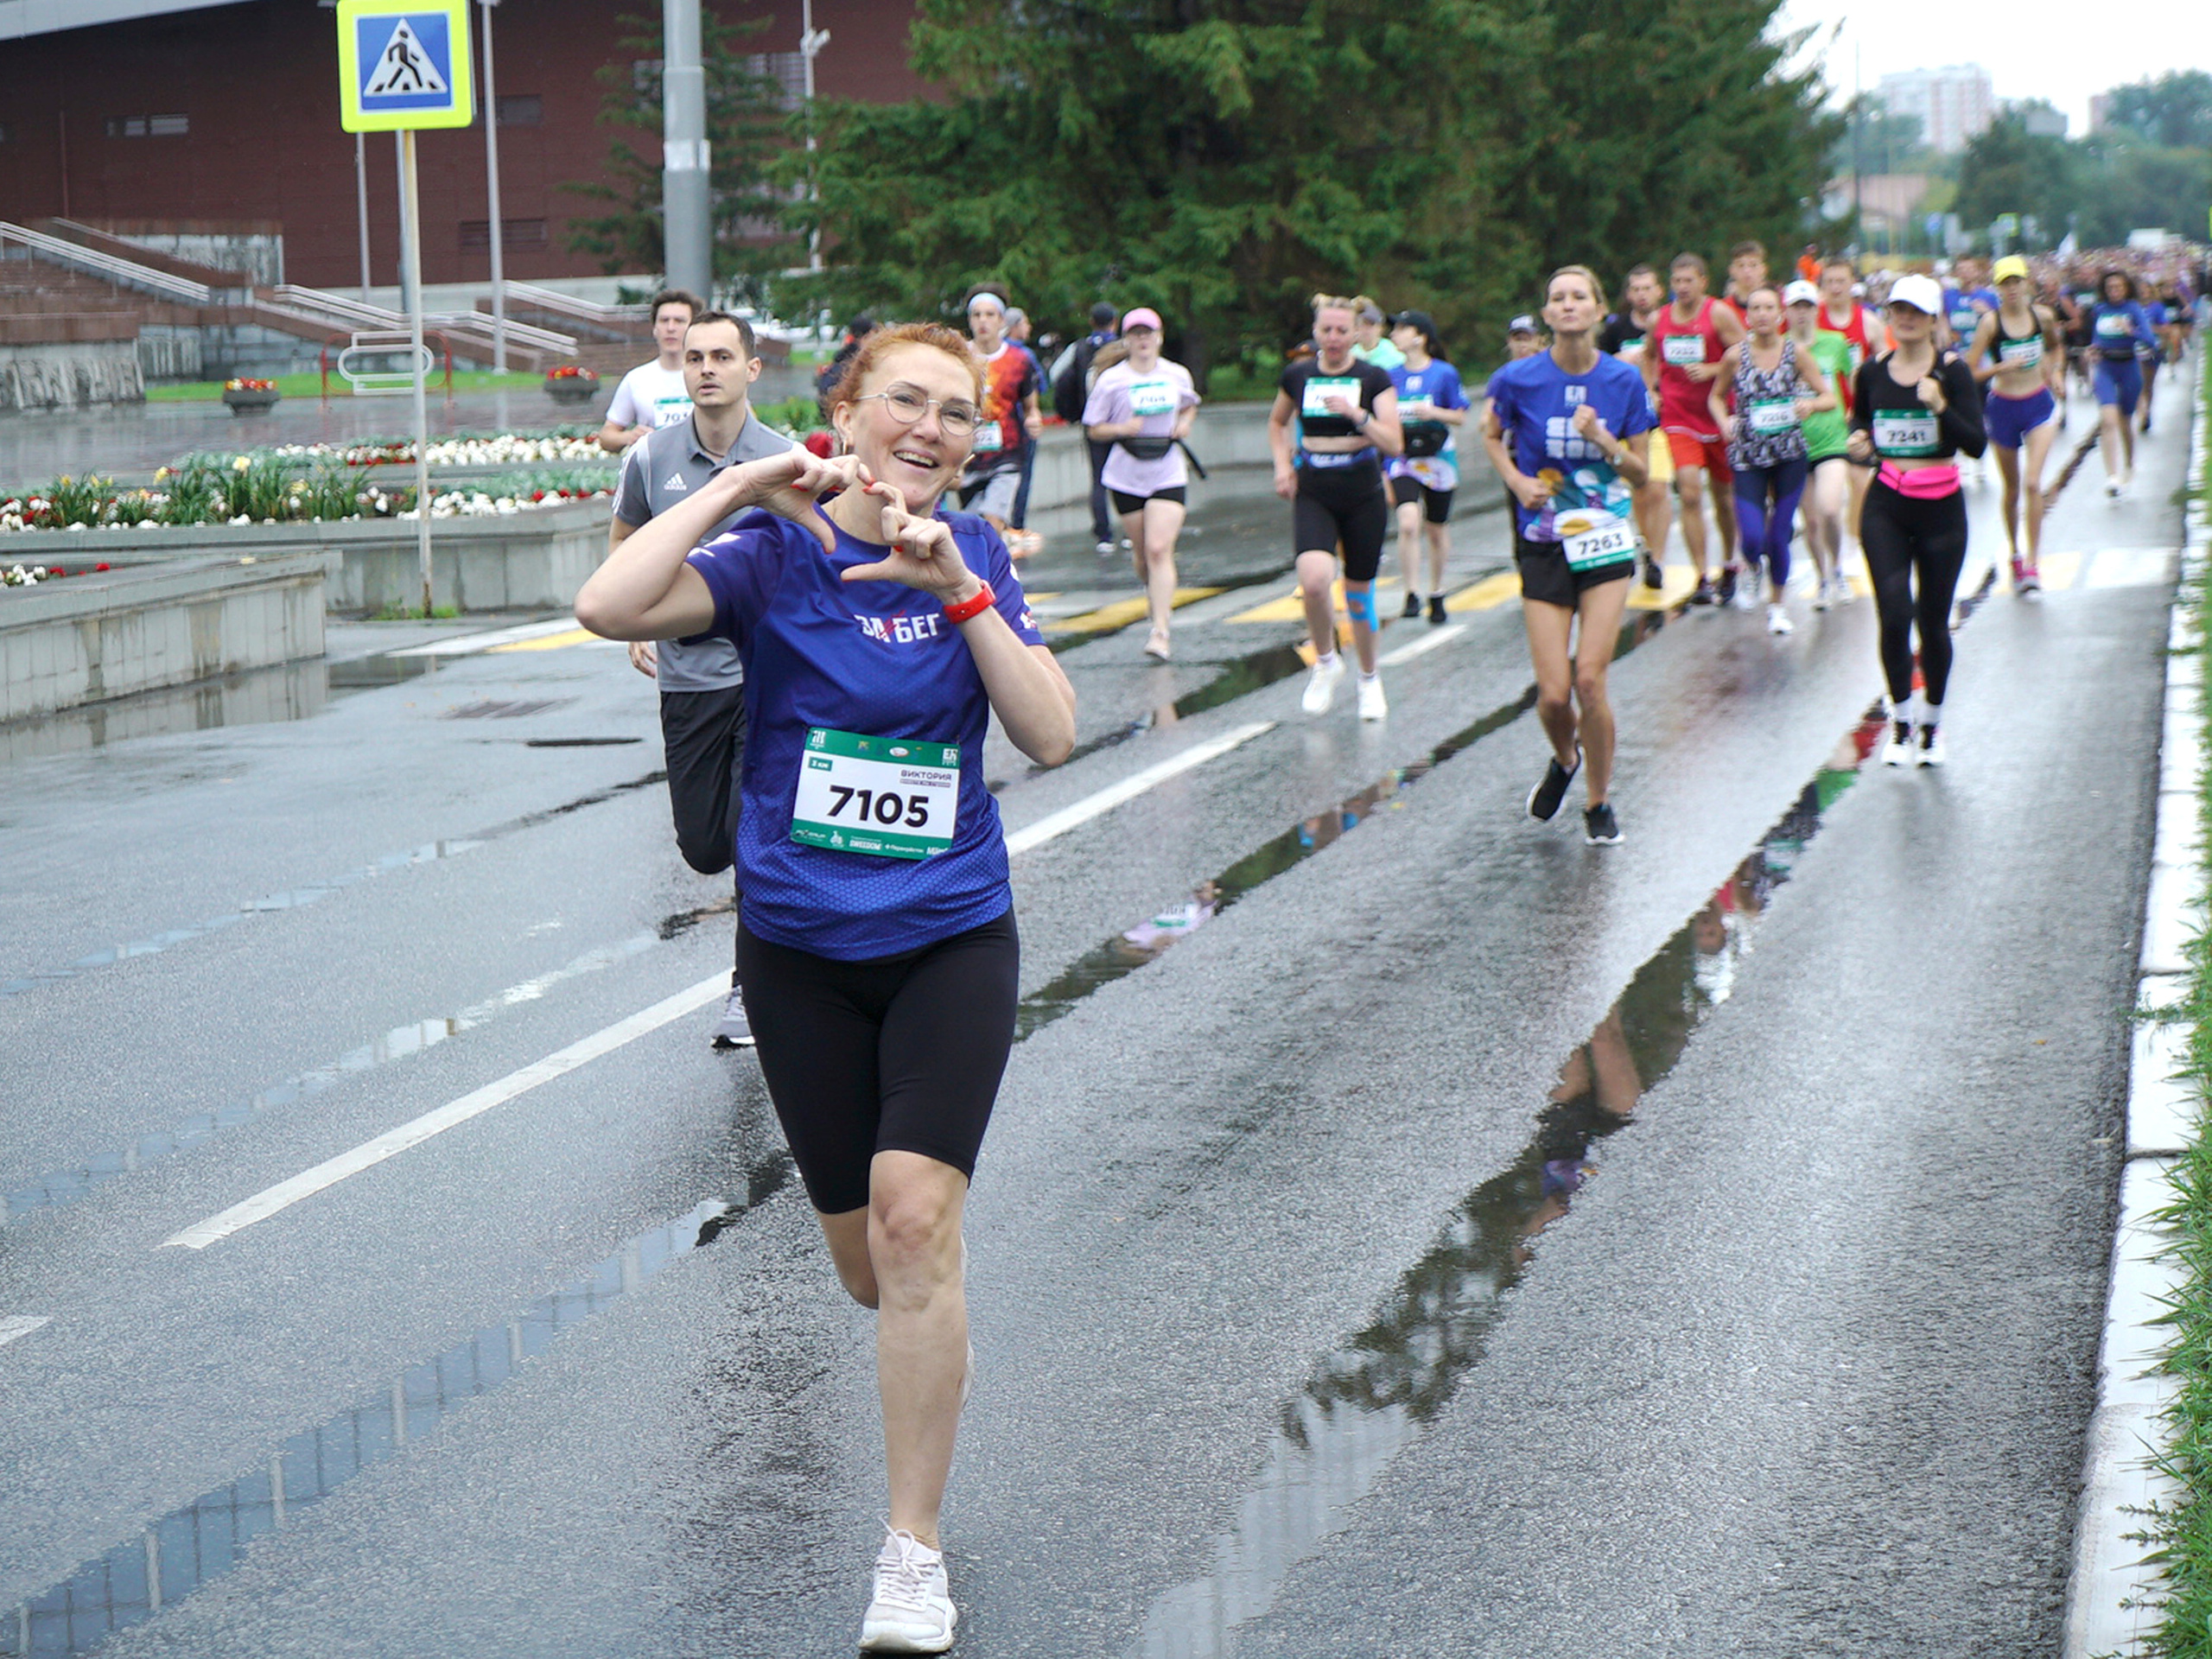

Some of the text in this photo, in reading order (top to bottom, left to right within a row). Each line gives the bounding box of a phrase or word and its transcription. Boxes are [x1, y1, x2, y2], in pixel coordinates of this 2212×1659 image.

[1886, 429, 1926, 442] 7241
[1578, 532, 1624, 555] 7263
[900, 769, 952, 781] ВИКТОРИЯ
[827, 784, 930, 829] 7105
